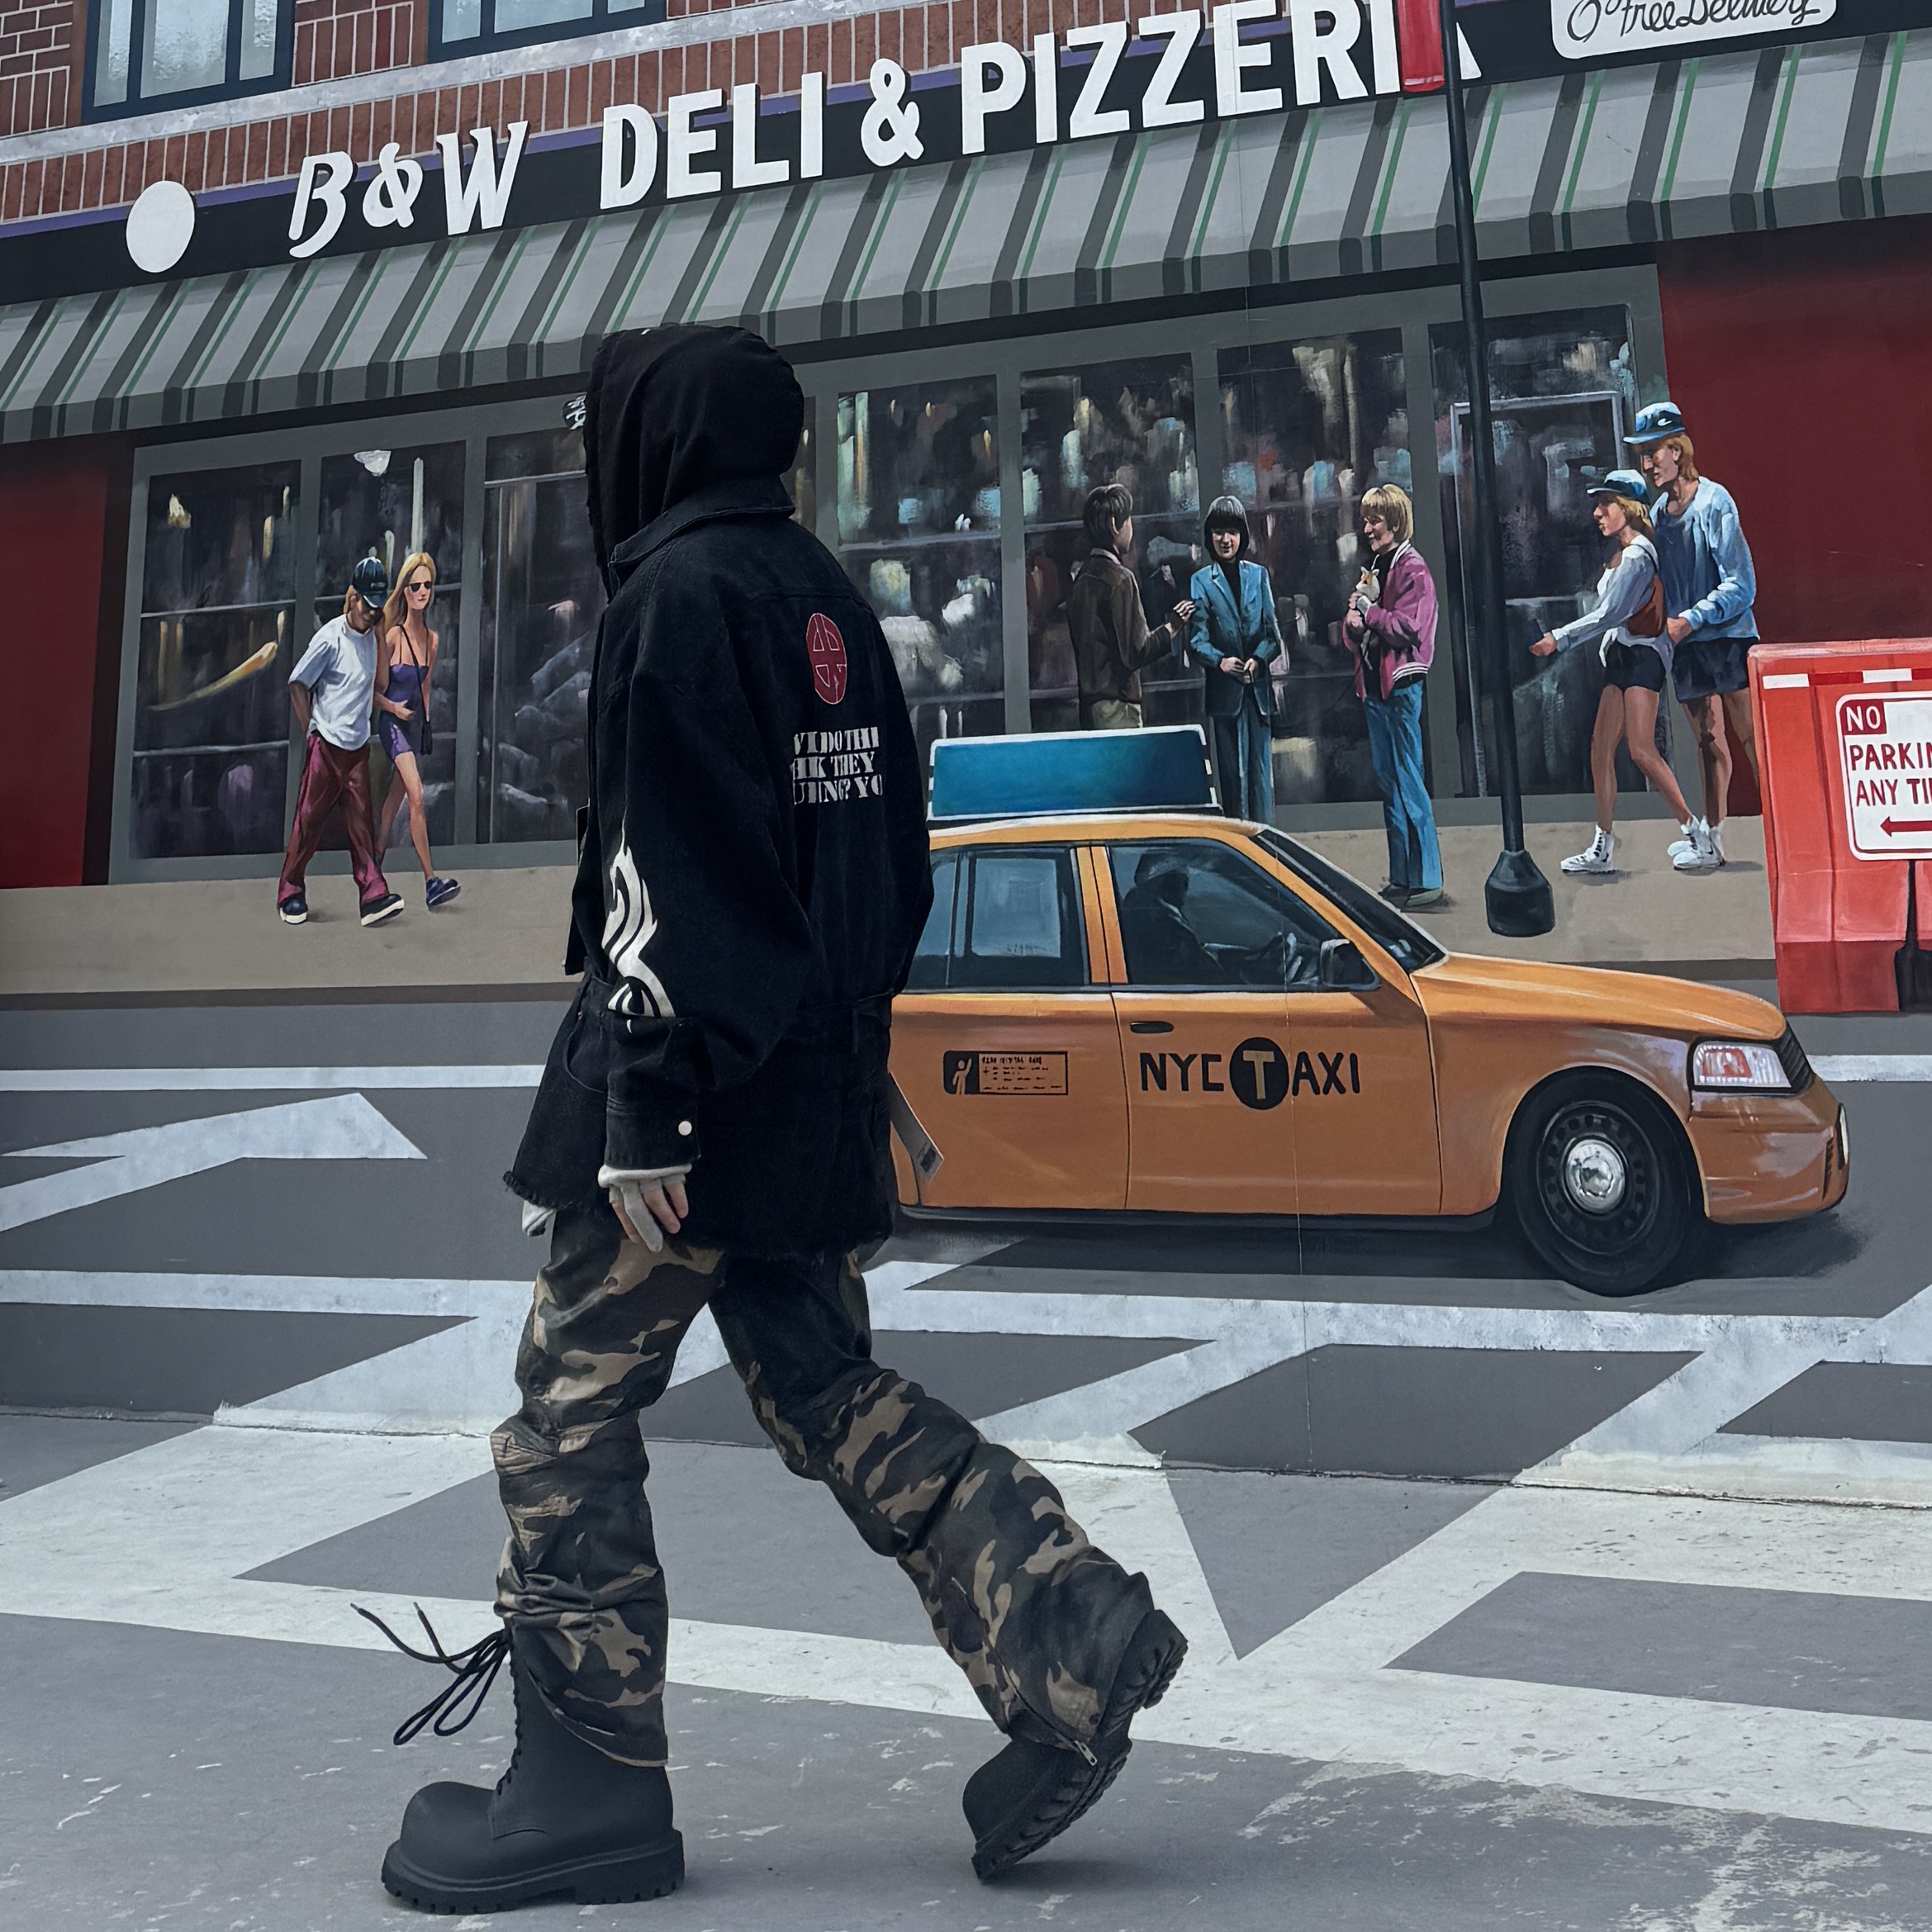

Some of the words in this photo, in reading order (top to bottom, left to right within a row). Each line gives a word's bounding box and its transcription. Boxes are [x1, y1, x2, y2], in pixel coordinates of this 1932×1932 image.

[600, 72, 824, 209] DELI
[861, 58, 924, 166] &
[961, 0, 1482, 155] PIZZERI
[1846, 705, 1881, 732] NO
[1856, 778, 1897, 807] ANY
[1140, 1052, 1222, 1092] NYC
